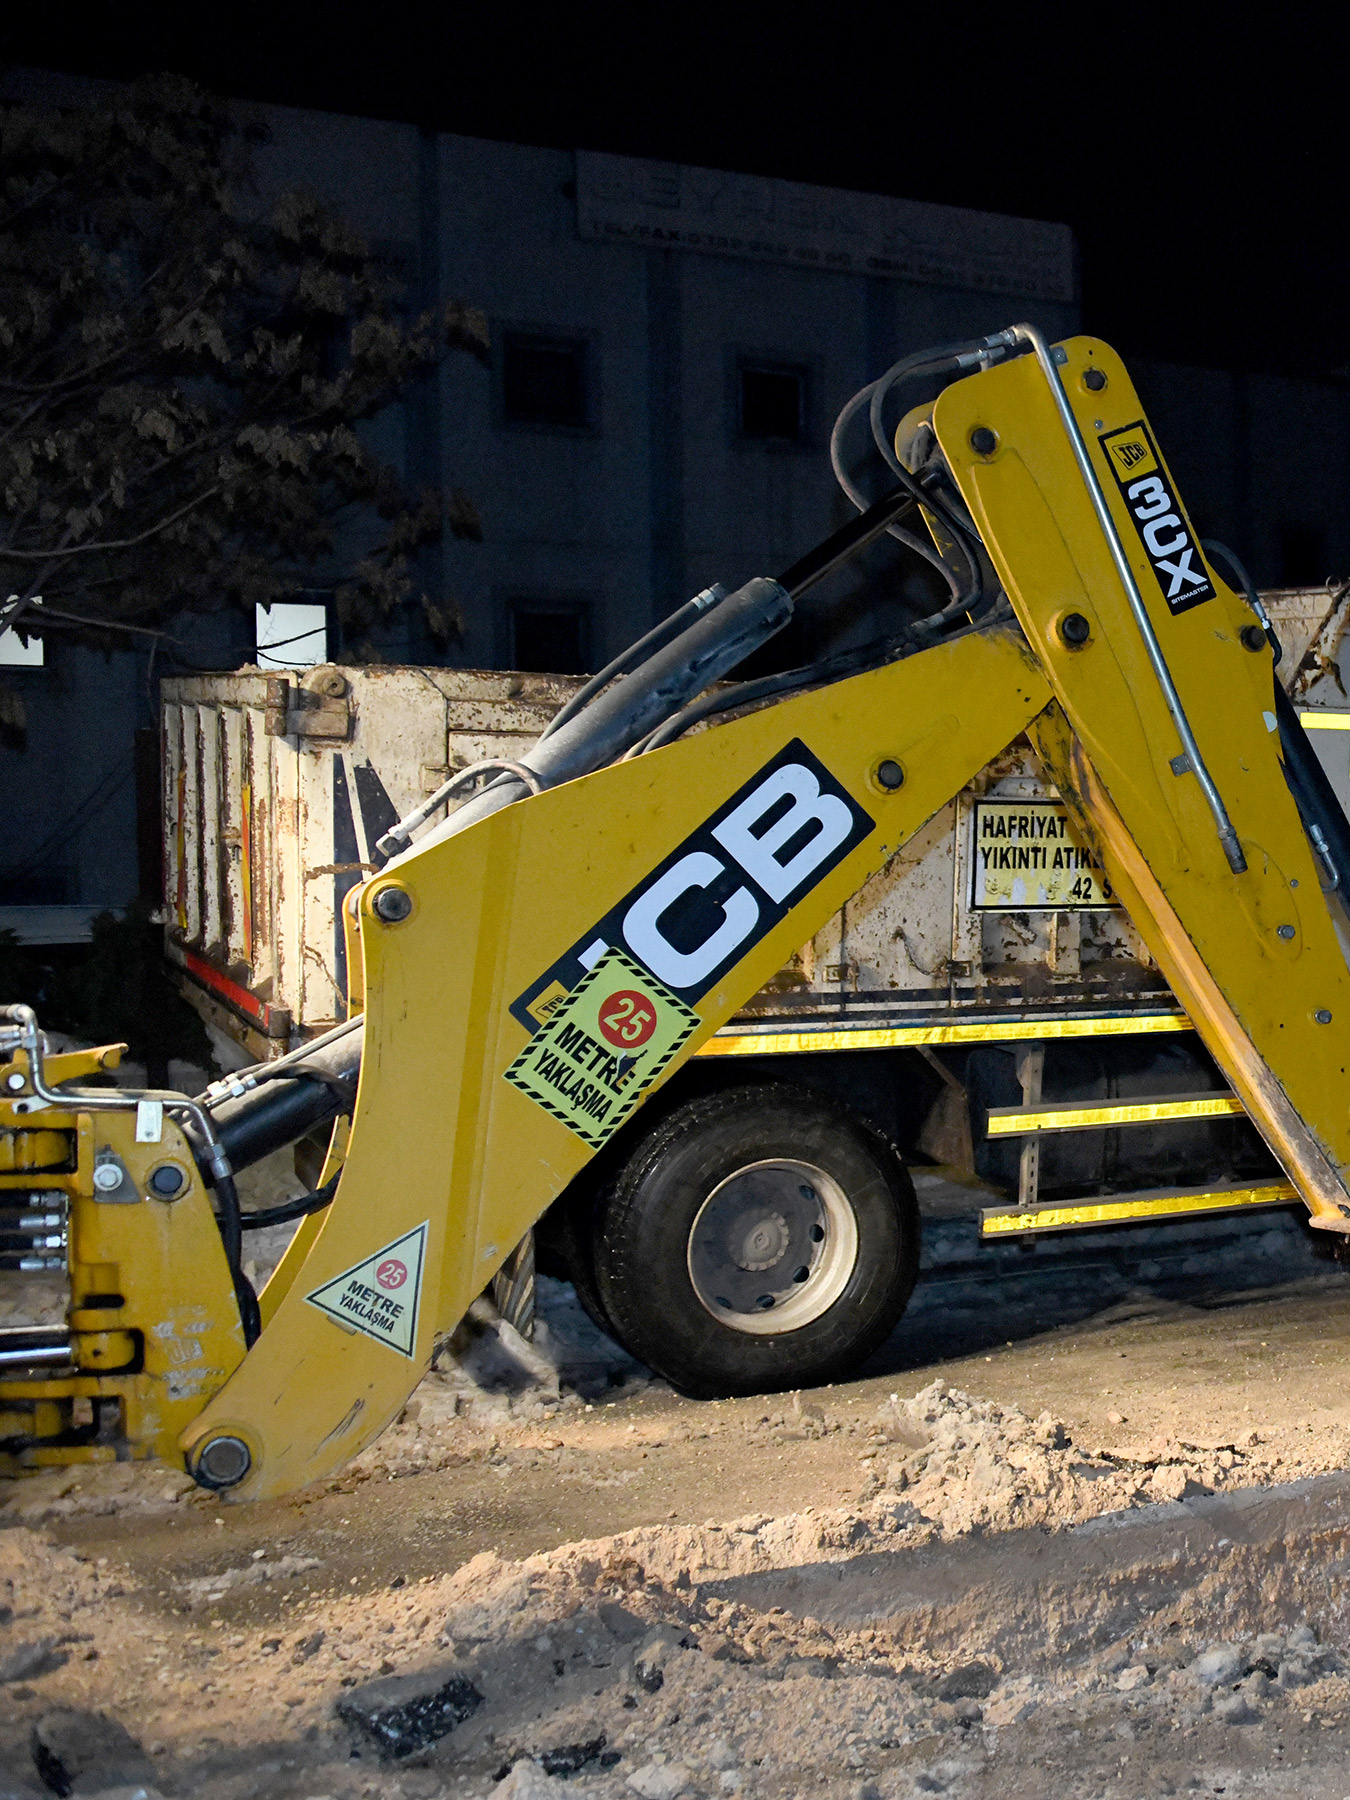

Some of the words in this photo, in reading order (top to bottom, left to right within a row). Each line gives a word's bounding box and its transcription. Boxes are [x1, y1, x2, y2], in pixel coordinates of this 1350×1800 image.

[1118, 445, 1146, 466] JCB
[1128, 476, 1207, 598] 3CX
[1171, 584, 1209, 604] SITEMASTER
[982, 810, 1067, 838] HAFRİYAT
[577, 763, 853, 988] CB
[980, 847, 1047, 869] YIKINTI
[1072, 877, 1092, 899] 42
[604, 997, 651, 1041] 25
[554, 1021, 636, 1096] METRE
[533, 1047, 613, 1124] YAKLAŞMA
[379, 1263, 405, 1286] 25
[339, 1293, 396, 1333] YAKLAŞMA
[347, 1280, 404, 1319] METRE
